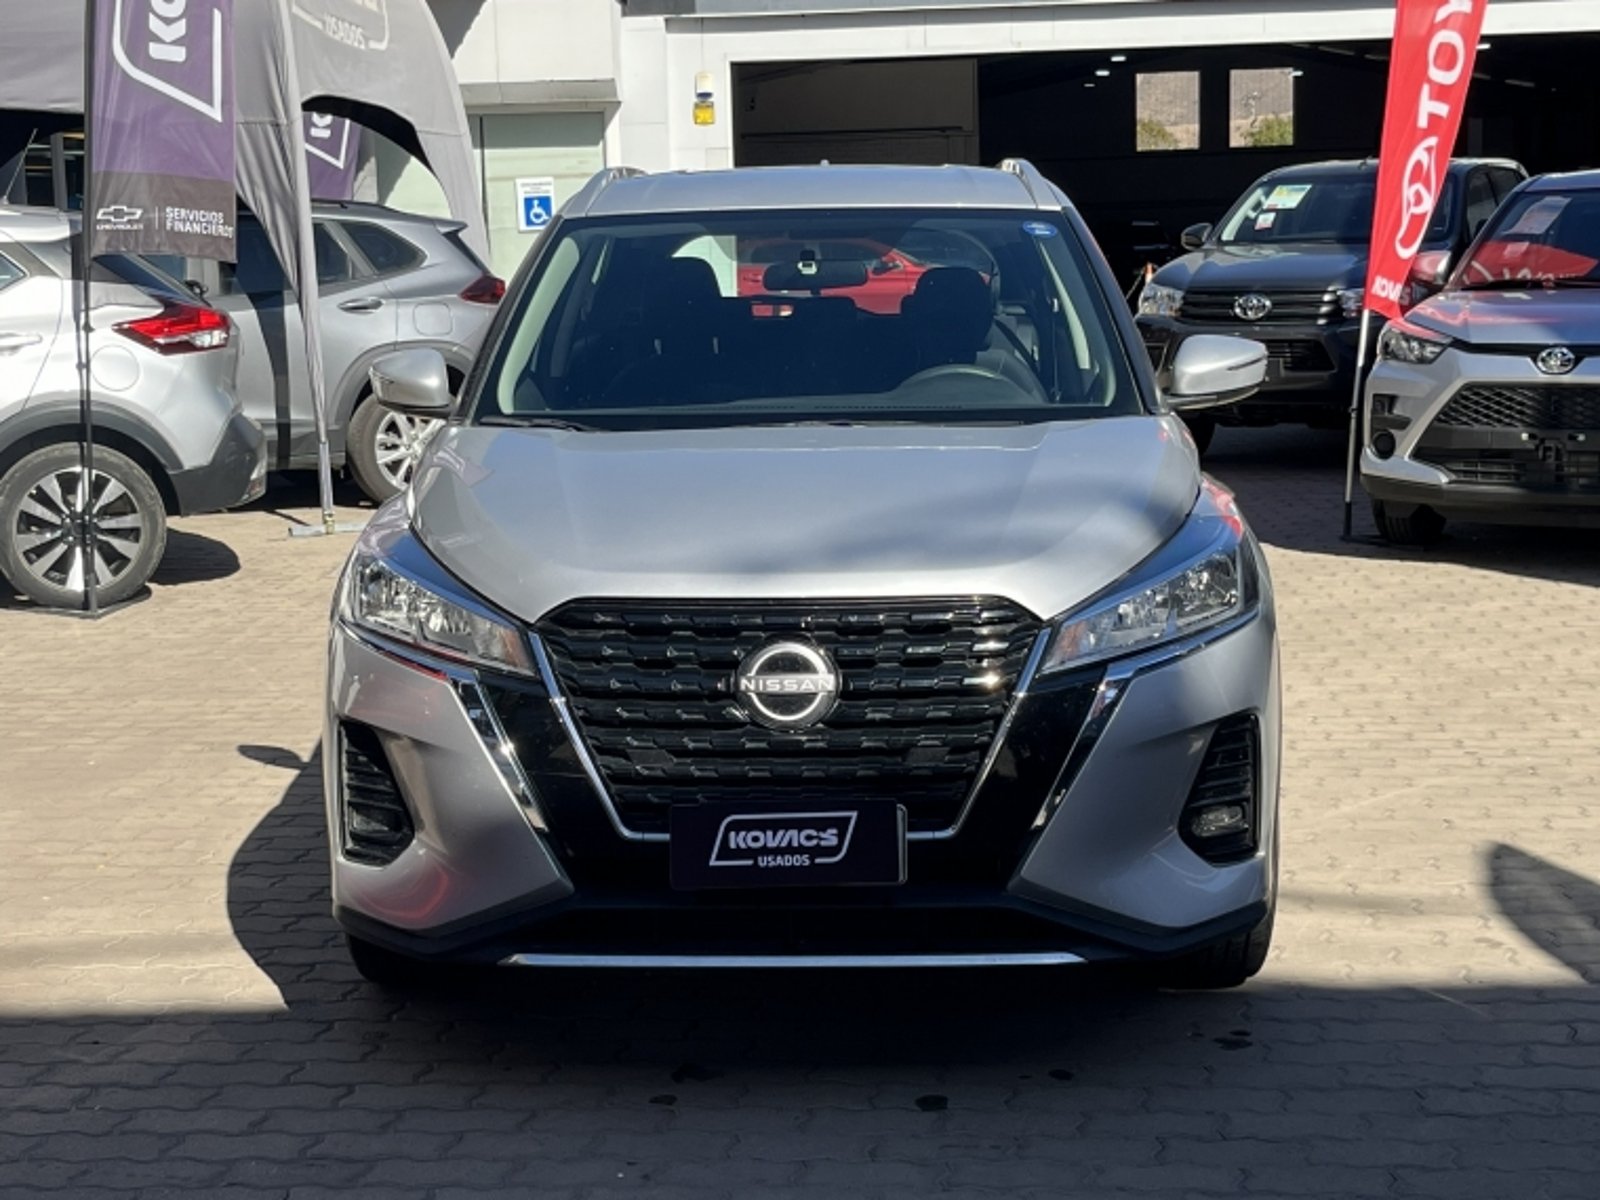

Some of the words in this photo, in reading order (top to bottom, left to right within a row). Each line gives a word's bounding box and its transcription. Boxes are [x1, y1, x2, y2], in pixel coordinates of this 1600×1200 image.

[165, 206, 225, 225] SERVICIOS
[165, 219, 235, 239] FINANCIEROS
[740, 676, 835, 692] NISSAN
[728, 828, 839, 850] KOVACS
[757, 854, 811, 868] USADOS
